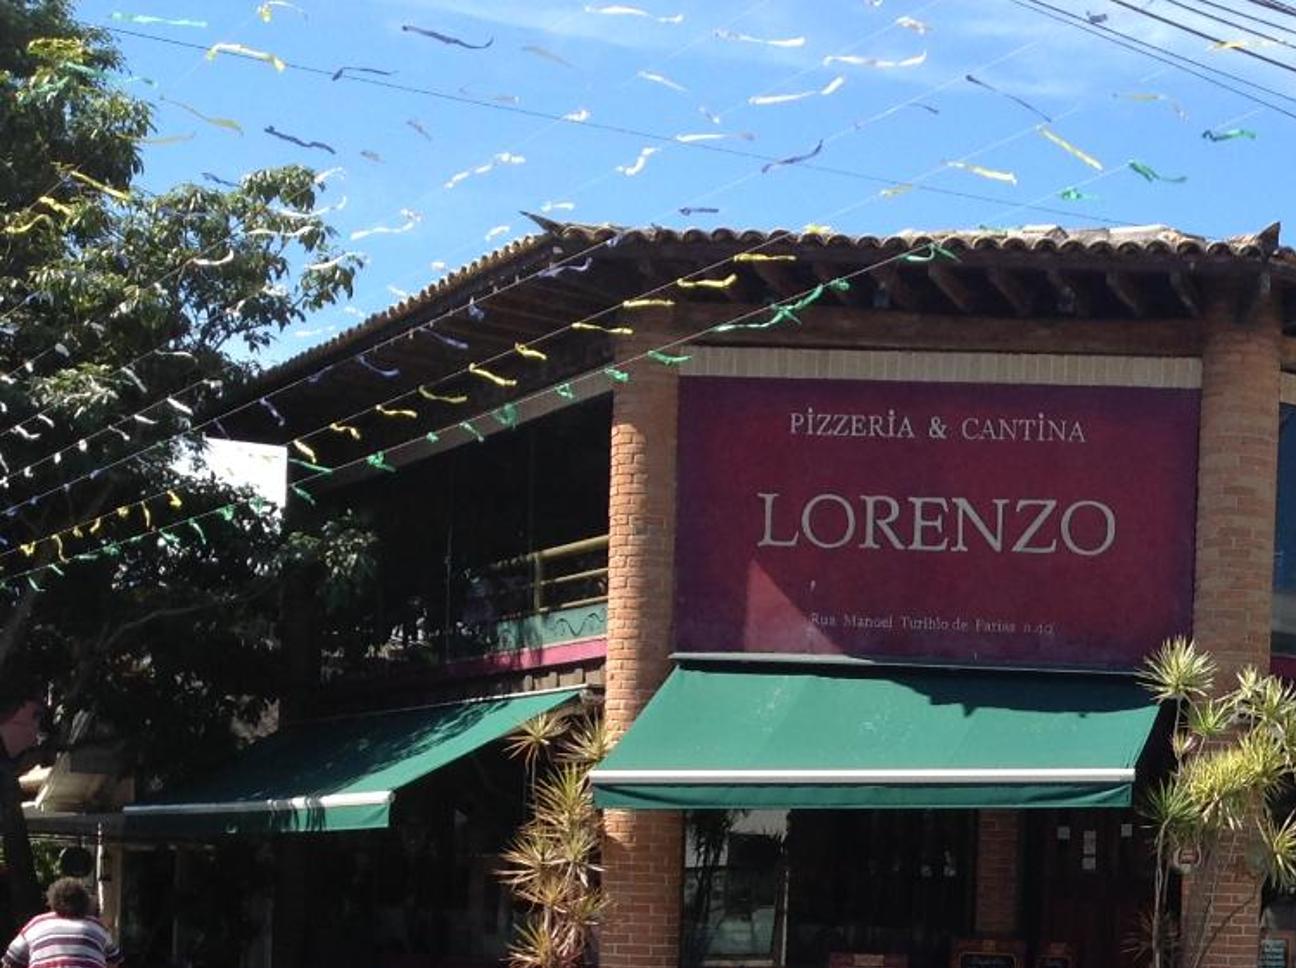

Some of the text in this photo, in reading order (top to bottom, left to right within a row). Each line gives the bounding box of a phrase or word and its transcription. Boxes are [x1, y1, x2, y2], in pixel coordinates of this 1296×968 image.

[929, 416, 948, 440] &
[756, 492, 1116, 557] LORENZO
[810, 611, 836, 627] Rua
[952, 615, 970, 632] de
